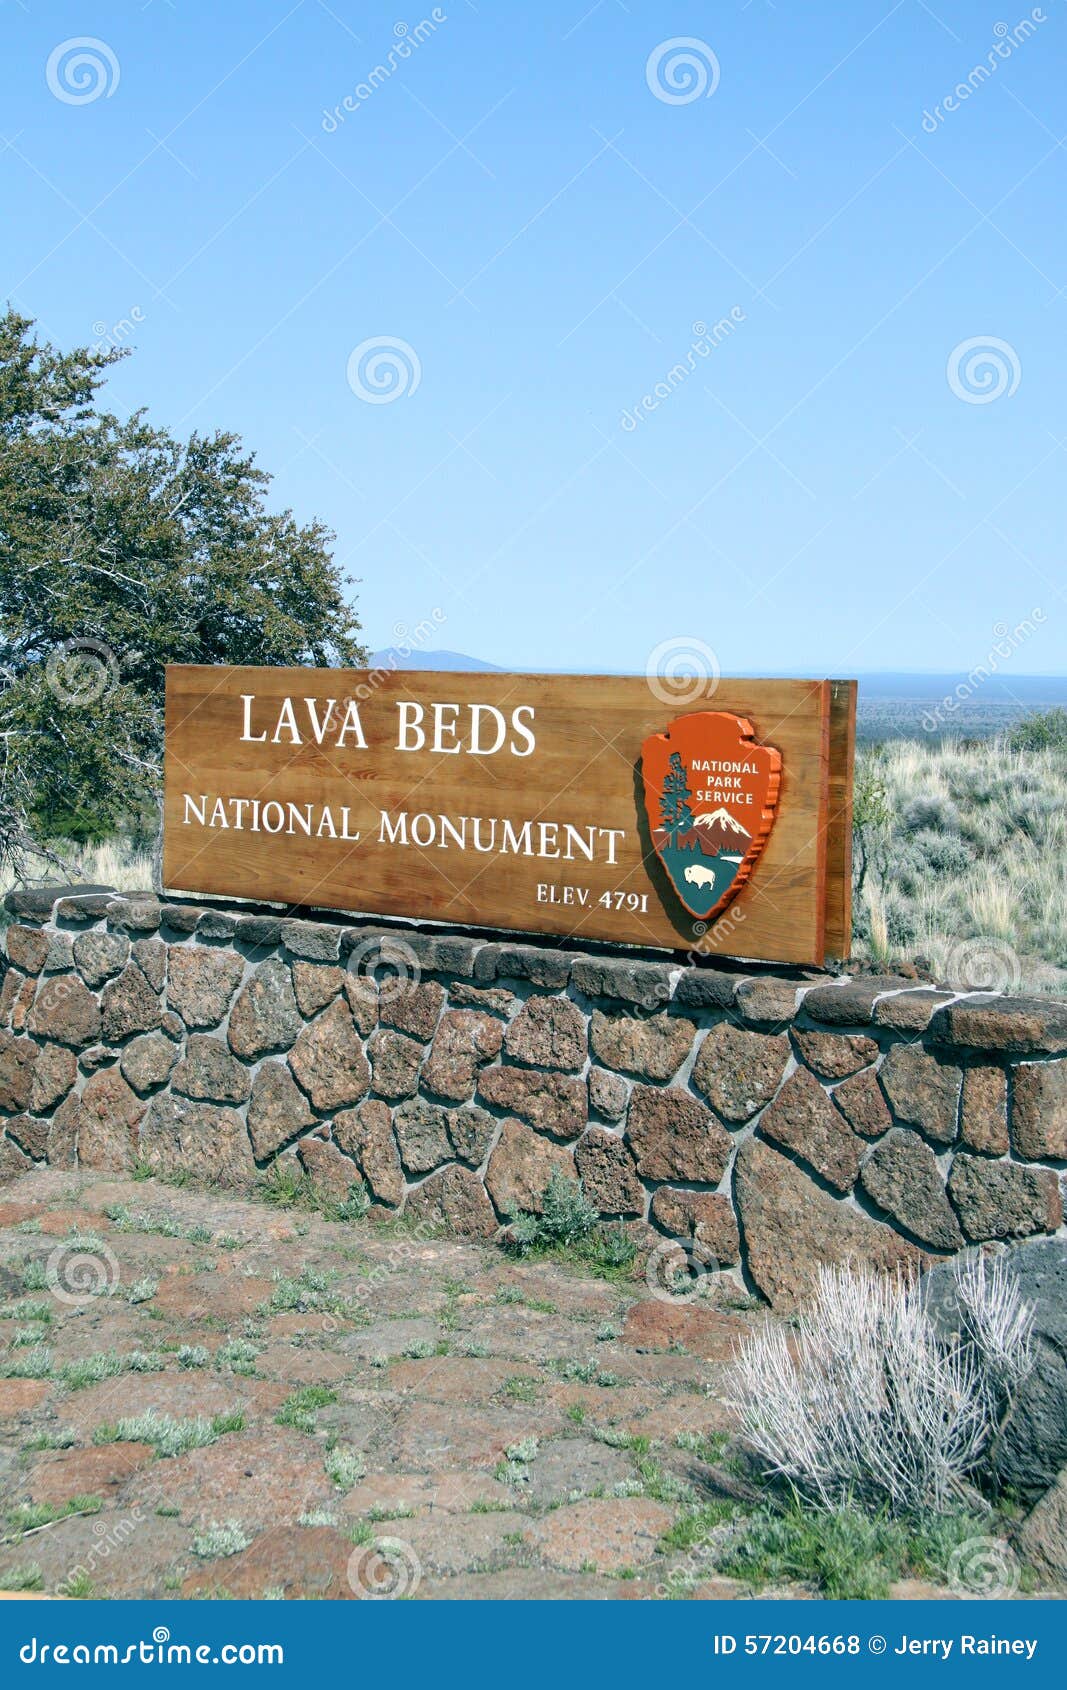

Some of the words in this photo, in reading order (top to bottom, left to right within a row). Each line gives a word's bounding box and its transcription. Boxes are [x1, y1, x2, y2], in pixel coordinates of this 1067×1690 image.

[239, 694, 369, 749] LAVA
[394, 701, 536, 757] BEDS
[692, 759, 759, 774] NATIONAL
[707, 776, 742, 788] PARK
[696, 790, 753, 804] SERVICE
[182, 793, 360, 841] NATIONAL
[378, 810, 625, 865] MONUMENT
[537, 883, 592, 908] ELEV.
